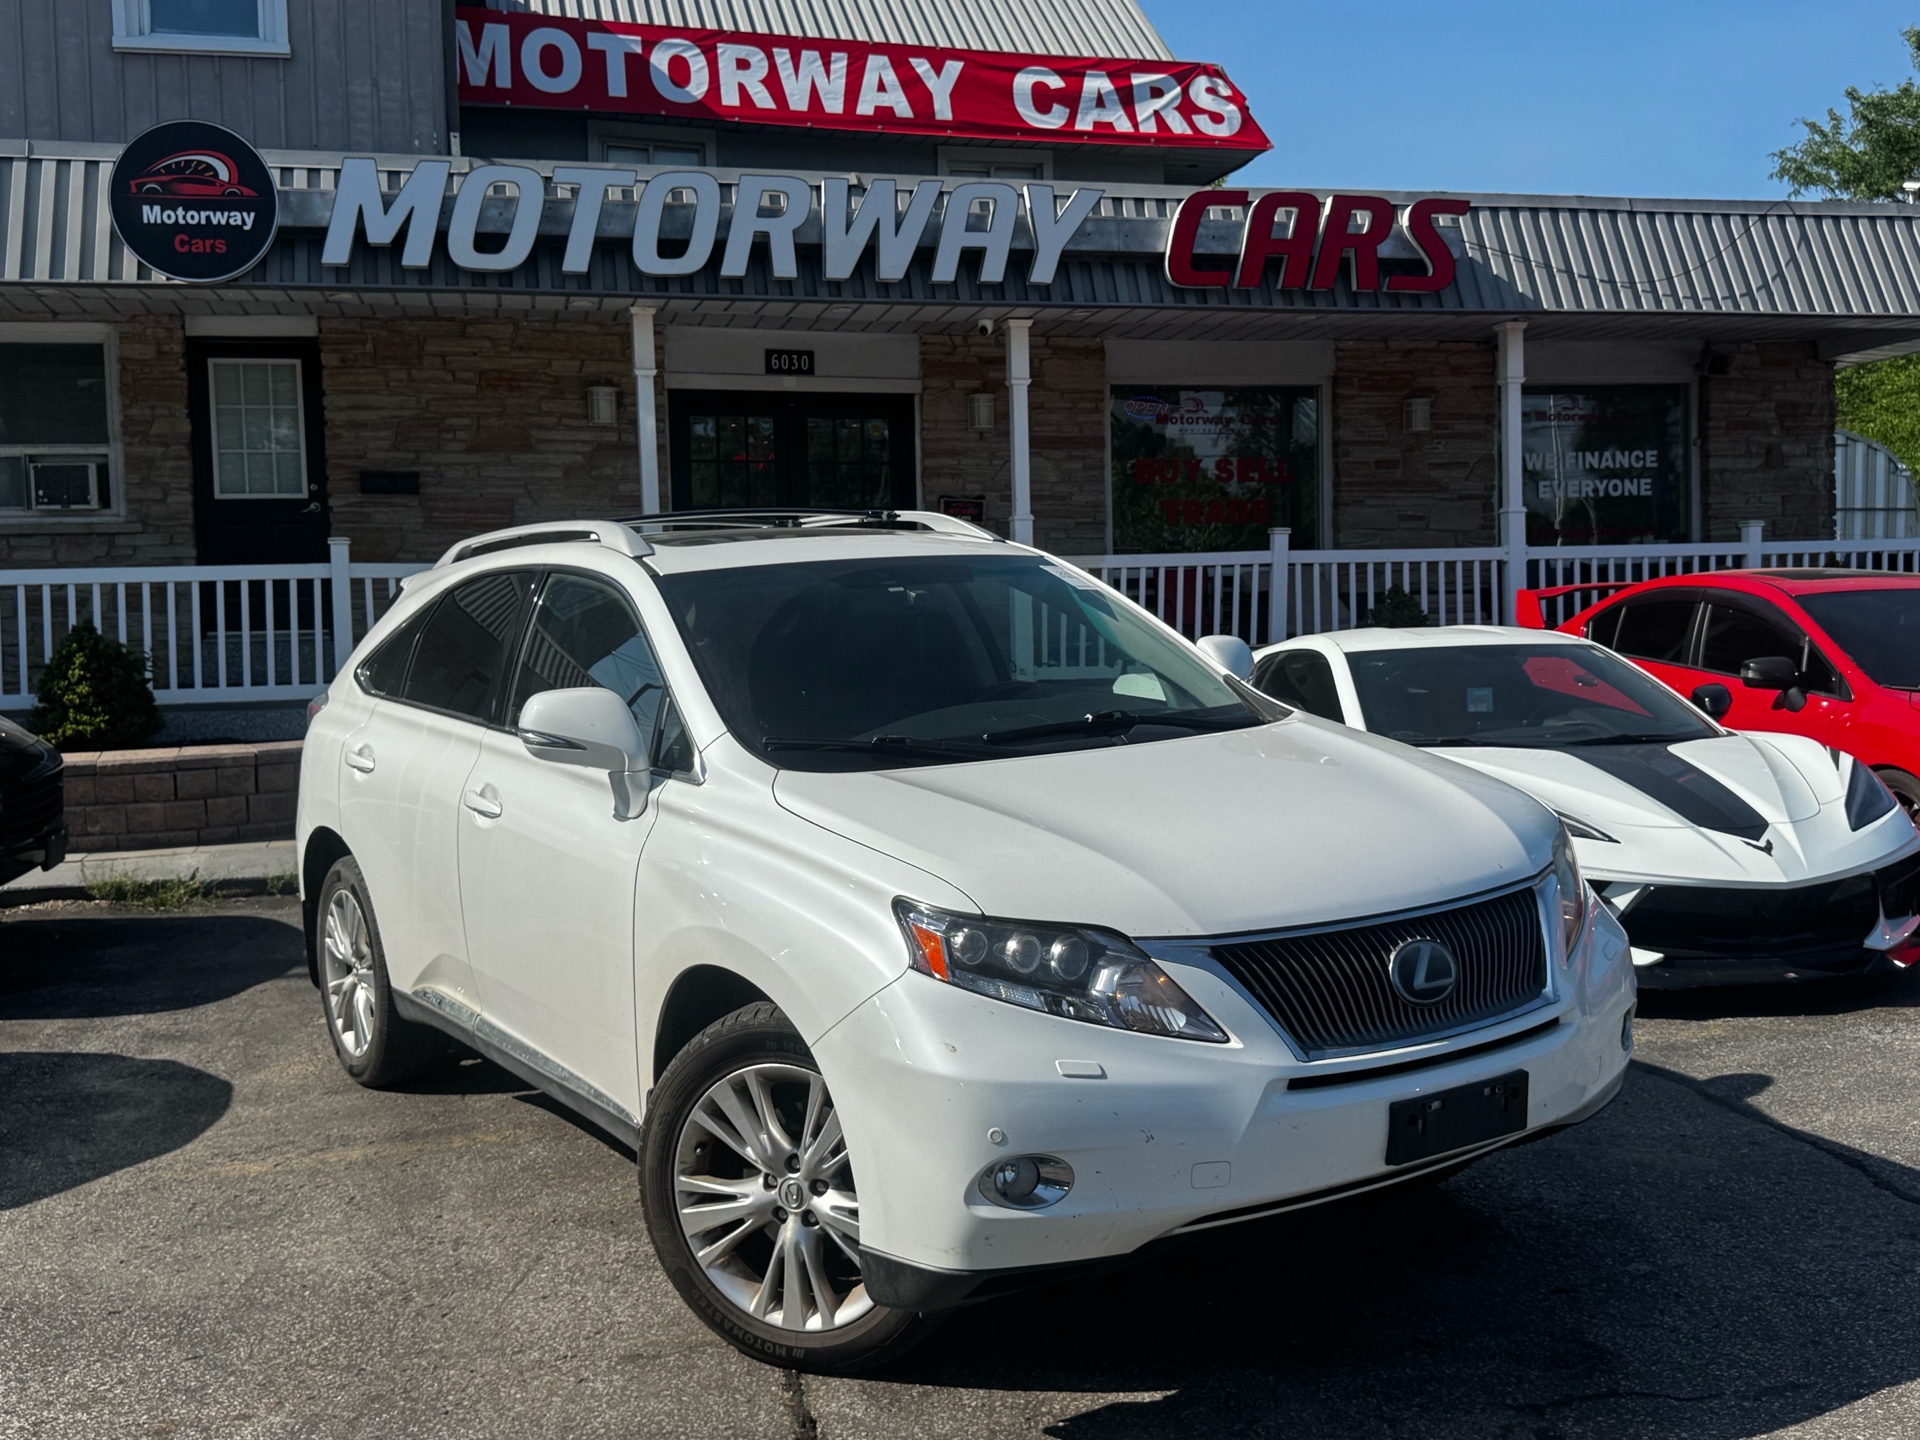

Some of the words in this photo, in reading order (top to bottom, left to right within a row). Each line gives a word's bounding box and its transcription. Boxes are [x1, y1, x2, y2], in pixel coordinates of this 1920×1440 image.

[456, 20, 965, 121] MOTORWAY
[1013, 66, 1243, 138] CARS
[142, 204, 256, 230] Motorway
[320, 157, 1104, 284] MOTORWAY
[1164, 190, 1471, 292] CARS
[174, 233, 227, 253] Cars
[771, 353, 810, 371] 6030
[1124, 400, 1169, 416] OPEN
[1155, 413, 1234, 428] Motorway
[1133, 458, 1203, 484] BUY
[1214, 457, 1294, 483] SELL
[1525, 451, 1556, 471] WE
[1564, 449, 1659, 470] FINANCE
[1538, 478, 1653, 499] EVERYONE
[1160, 498, 1270, 526] TRADE
[691, 1287, 788, 1357] MOTOMASTER
